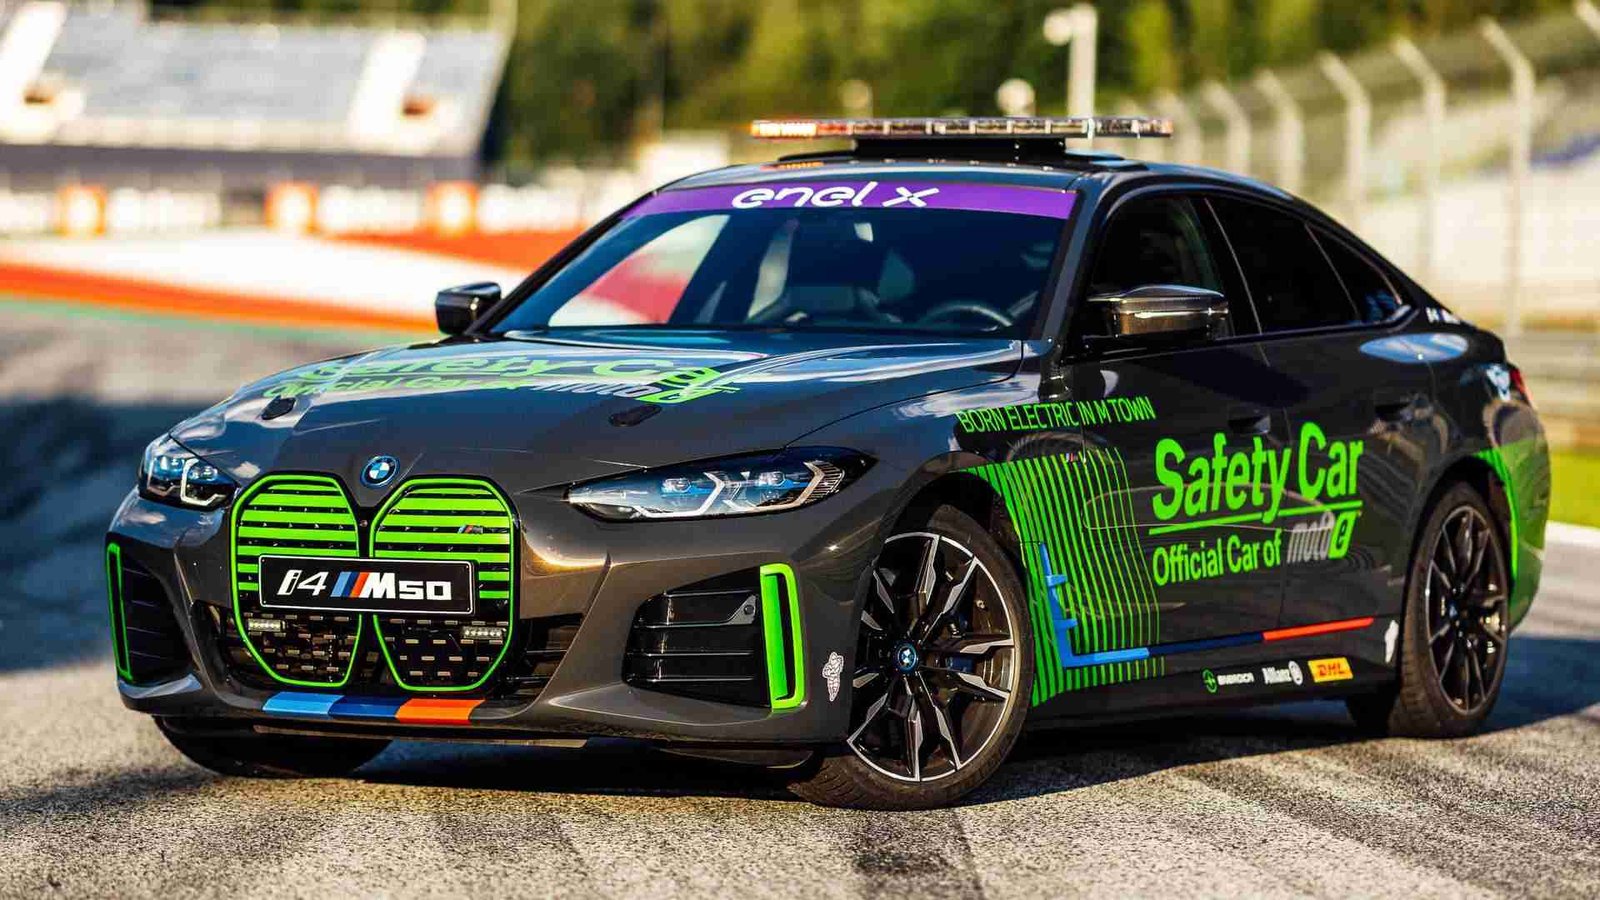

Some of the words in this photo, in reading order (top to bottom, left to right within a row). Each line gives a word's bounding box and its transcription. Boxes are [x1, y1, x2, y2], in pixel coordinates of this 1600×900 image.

[732, 181, 878, 209] enel
[955, 408, 1007, 433] BORN
[1006, 402, 1079, 431] ELECTRIC
[1077, 400, 1095, 426] IN
[1094, 399, 1110, 424] M
[1107, 396, 1156, 422] TOWN
[1151, 432, 1292, 524] Safety
[1297, 421, 1364, 499] Car
[1152, 538, 1224, 586] Official
[1226, 534, 1260, 574] Car
[1263, 528, 1282, 568] of
[1316, 662, 1346, 677] DHL
